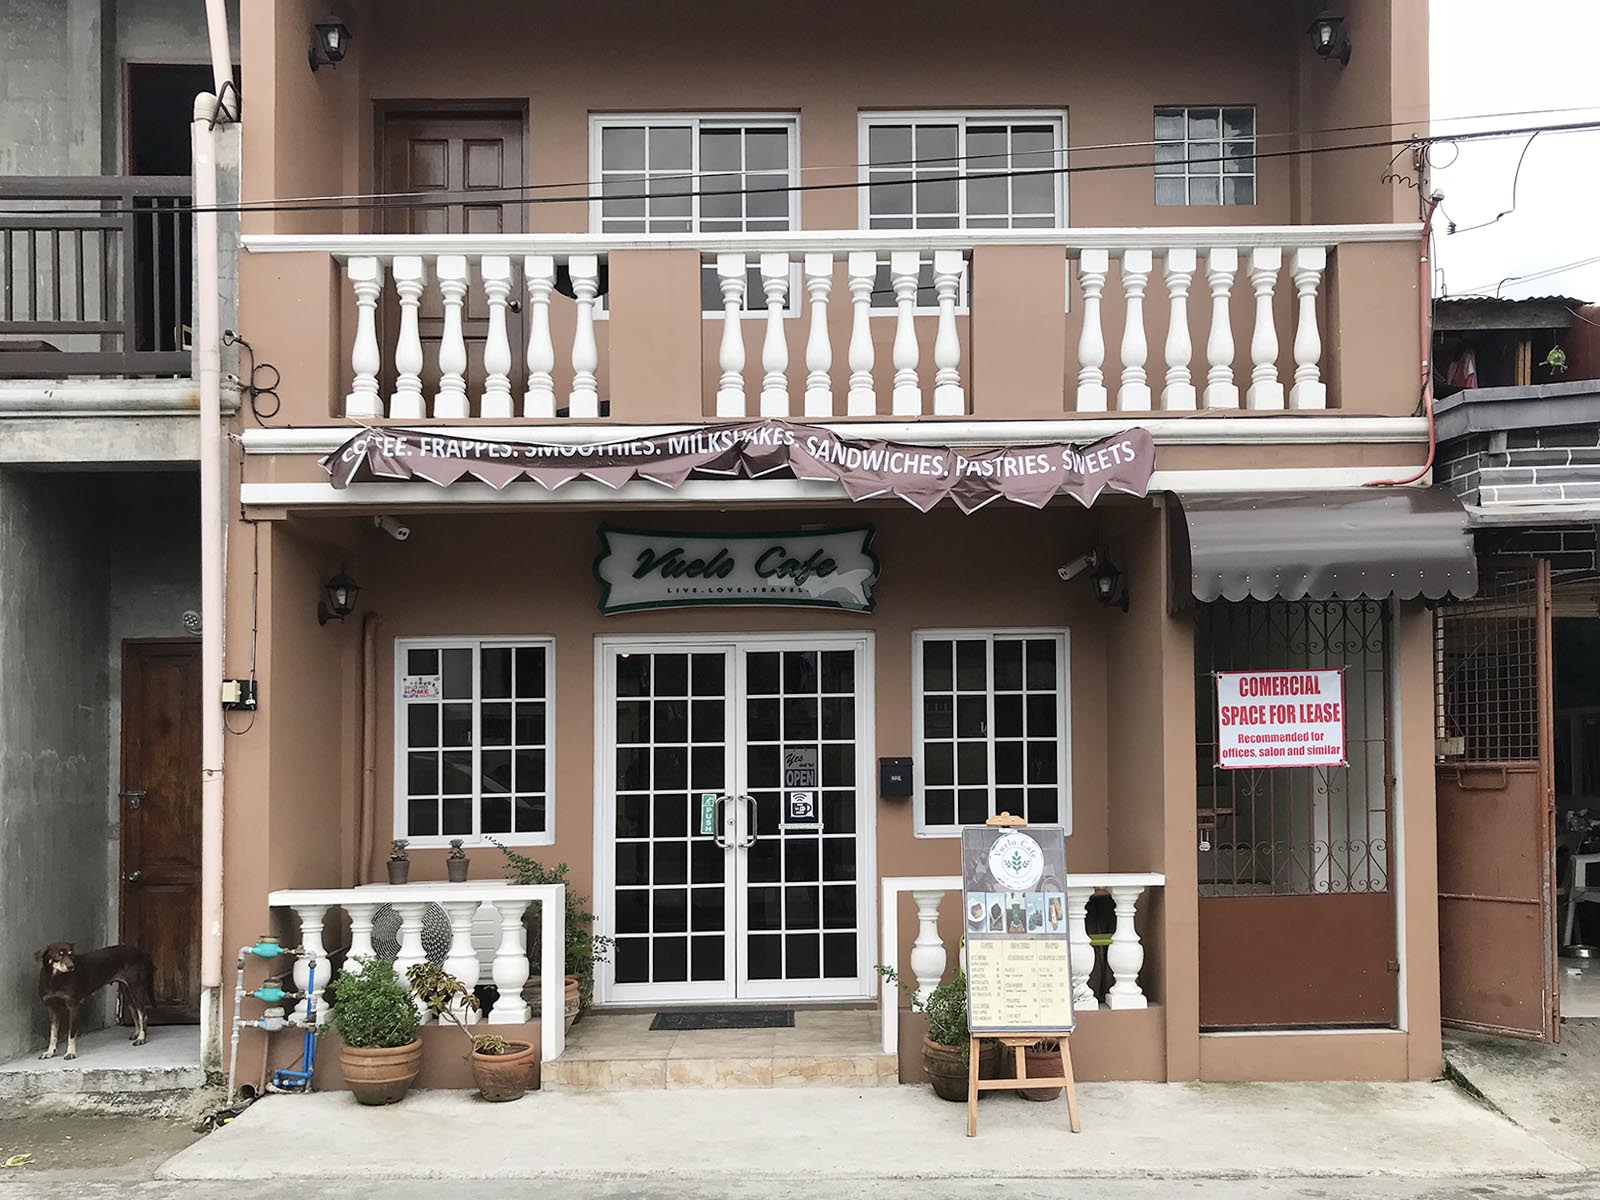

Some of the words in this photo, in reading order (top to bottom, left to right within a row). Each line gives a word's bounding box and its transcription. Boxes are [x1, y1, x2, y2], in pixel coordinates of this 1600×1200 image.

[342, 433, 412, 462] COEE.
[806, 436, 949, 477] SANDWICHES.
[955, 454, 1057, 477] PASTRIES.
[1062, 441, 1136, 475] SWEETS
[632, 548, 735, 579] Vuelo
[754, 546, 838, 586] Cafe
[1239, 675, 1321, 697] COMERCIAL
[1221, 705, 1266, 726] SPACE
[1269, 704, 1297, 724] FOR
[1299, 703, 1341, 723] LEASE
[1237, 731, 1309, 744] Recommended
[1310, 731, 1324, 742] for
[786, 753, 803, 767] Yes
[1222, 747, 1257, 758] offices,
[1258, 746, 1285, 757] salon
[1287, 746, 1305, 756] and
[1307, 745, 1340, 755] similar
[786, 770, 814, 786] OPEN
[705, 807, 713, 832] PUSH
